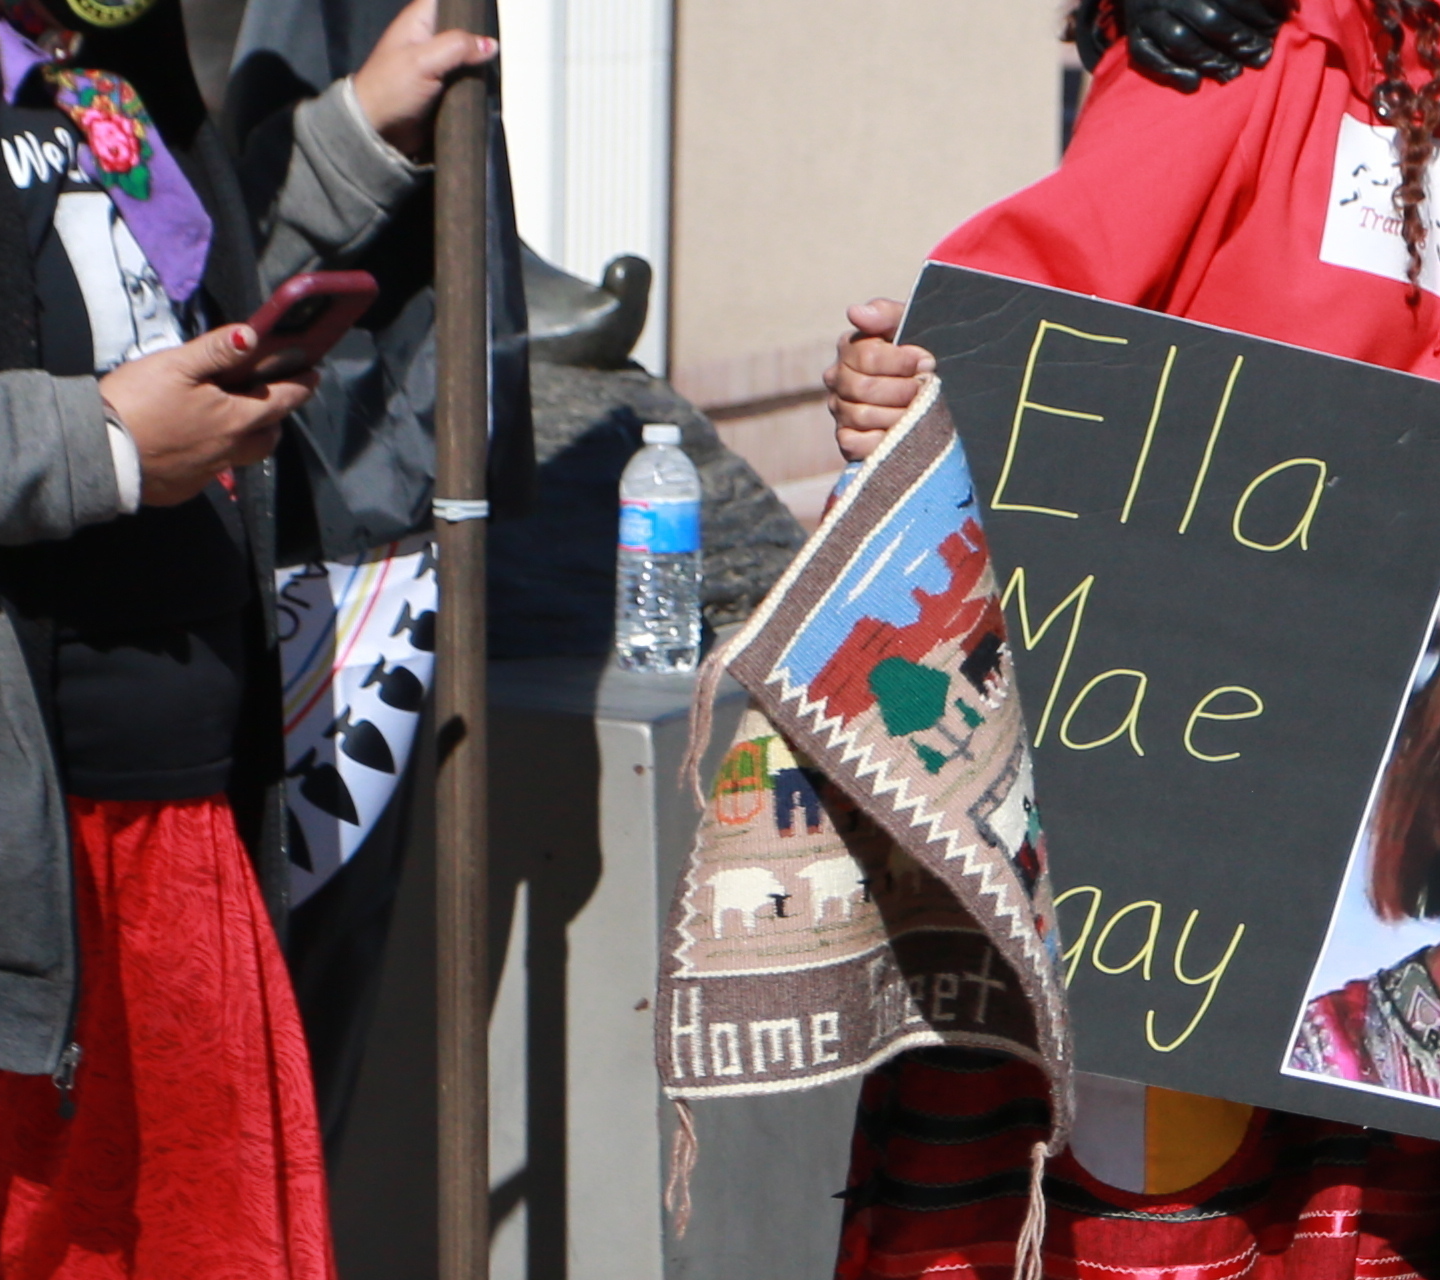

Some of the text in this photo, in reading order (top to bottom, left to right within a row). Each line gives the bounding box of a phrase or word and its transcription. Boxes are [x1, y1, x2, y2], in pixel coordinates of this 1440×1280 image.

[991, 319, 1327, 552] Ella
[999, 566, 1264, 763] Mae
[670, 986, 840, 1080] Home
[1052, 884, 1246, 1052] gay
